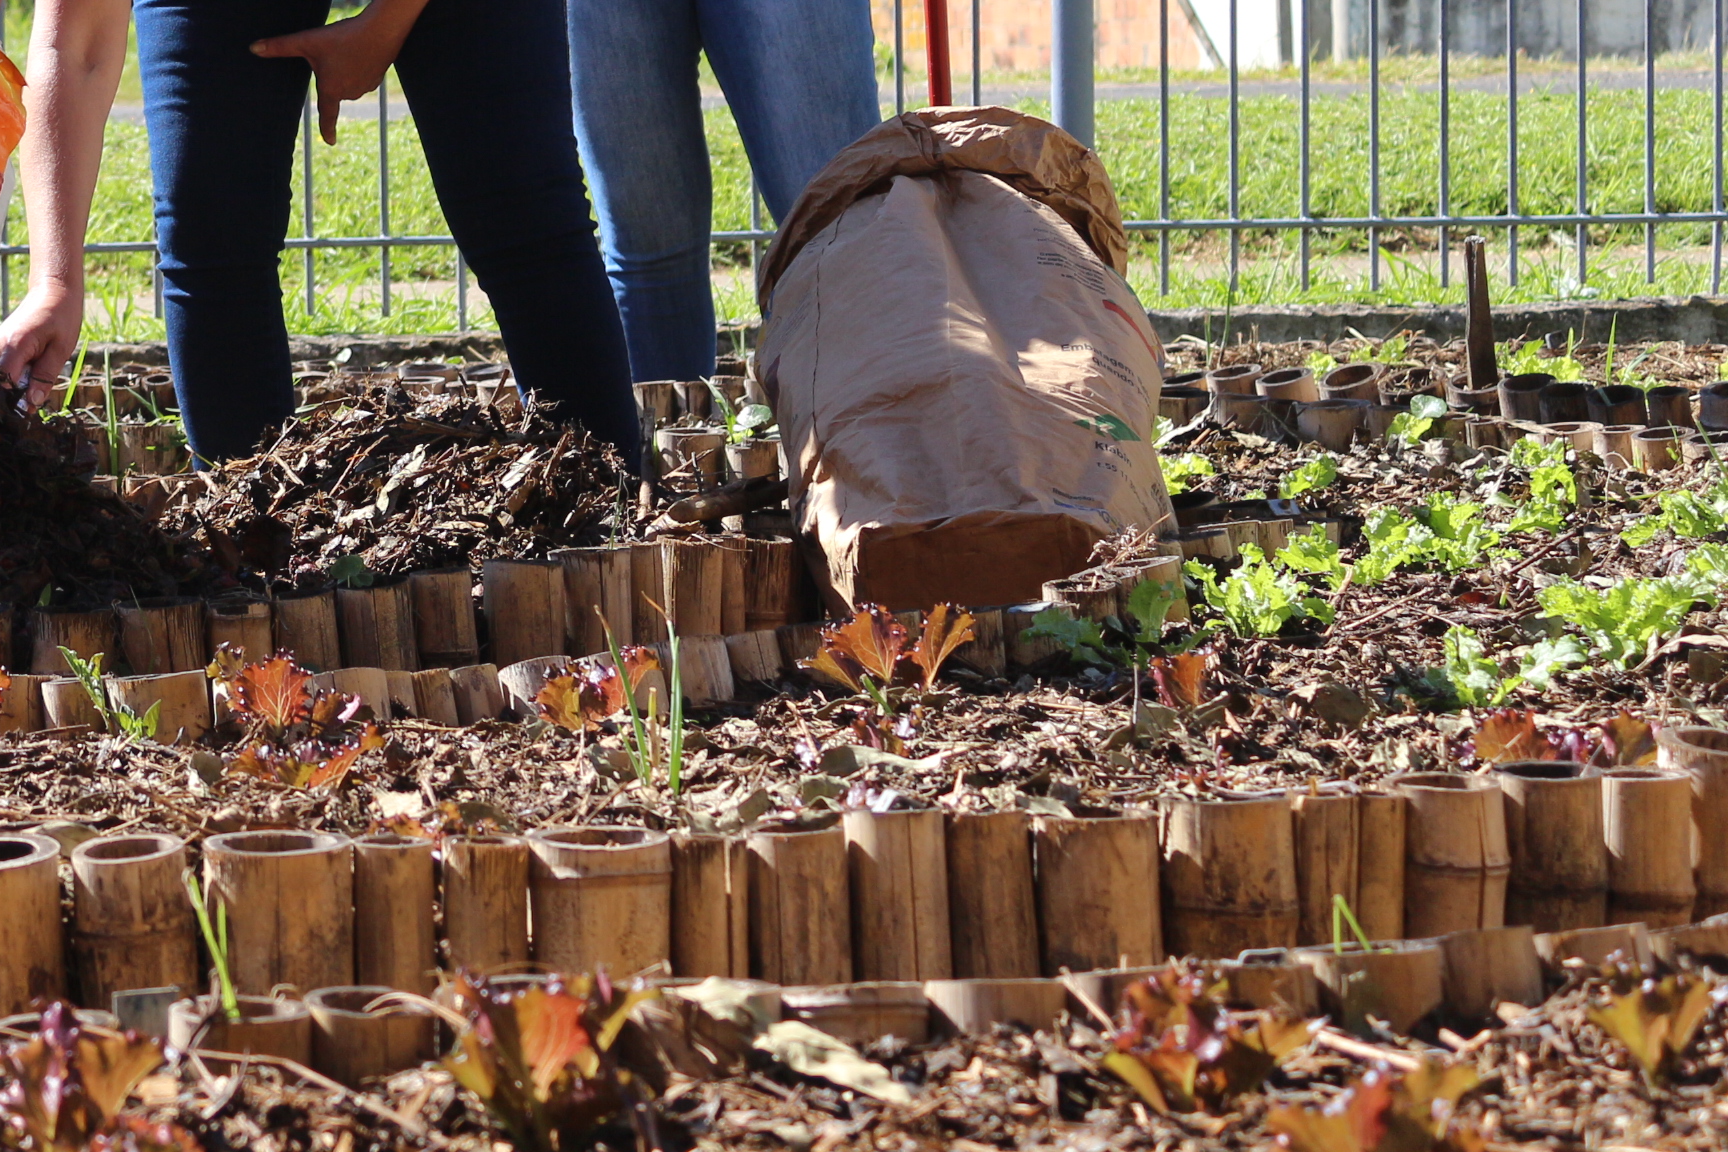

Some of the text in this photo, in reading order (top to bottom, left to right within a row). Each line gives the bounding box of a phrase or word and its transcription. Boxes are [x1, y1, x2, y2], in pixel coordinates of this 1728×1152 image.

[1060, 343, 1134, 376] Embalagem
[1092, 356, 1135, 387] quando
[1094, 441, 1132, 467] Klabin
